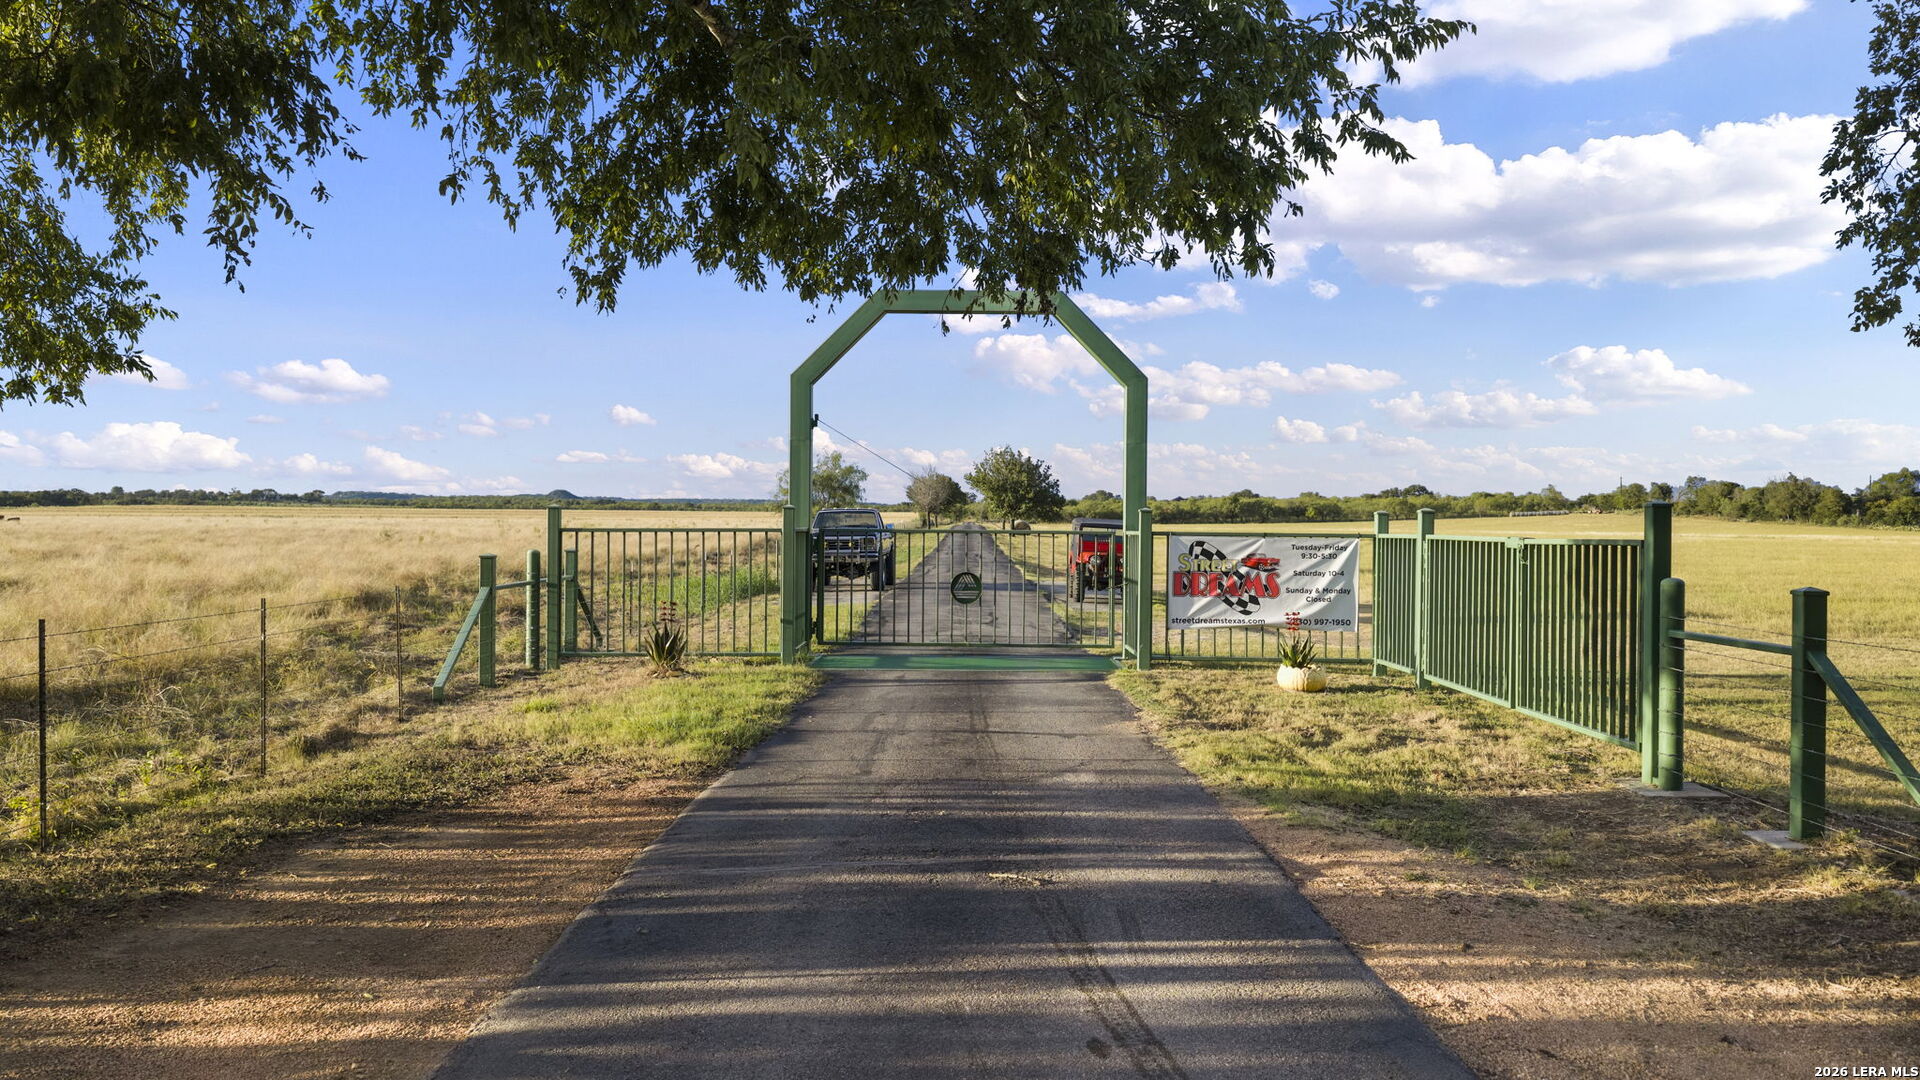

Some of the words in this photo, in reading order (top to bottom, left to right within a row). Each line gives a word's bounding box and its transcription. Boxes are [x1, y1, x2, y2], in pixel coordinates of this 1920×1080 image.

[1172, 570, 1282, 599] DREAMS
[1322, 587, 1352, 595] Monday
[1313, 618, 1352, 626] 997-1950
